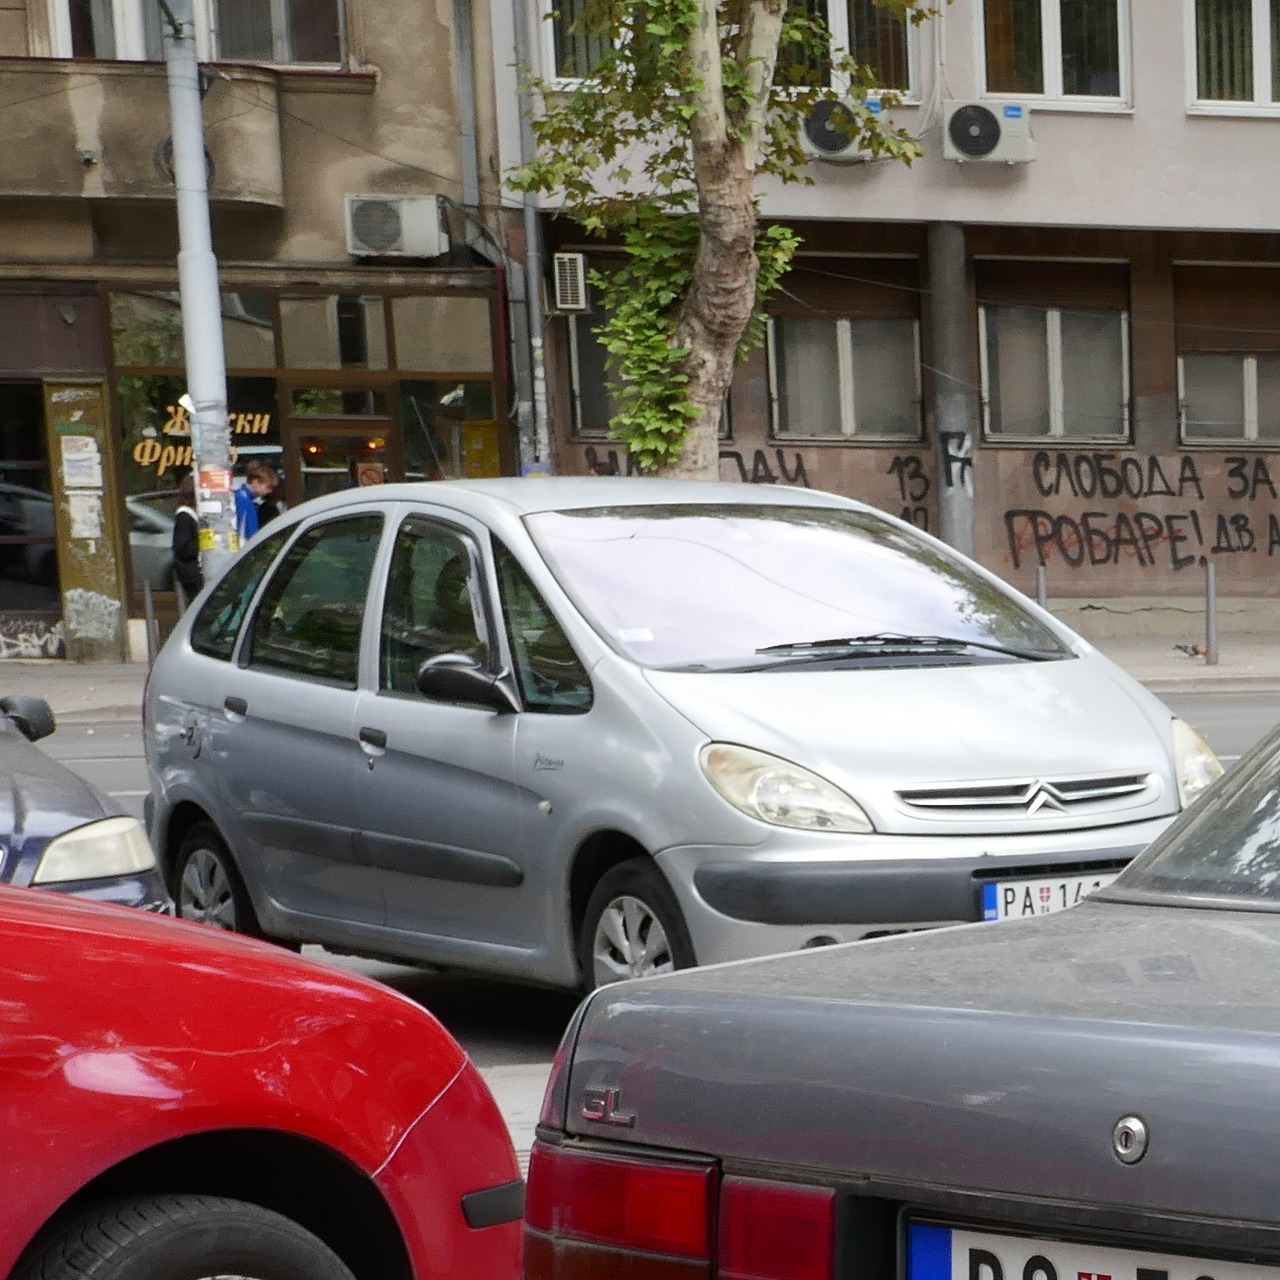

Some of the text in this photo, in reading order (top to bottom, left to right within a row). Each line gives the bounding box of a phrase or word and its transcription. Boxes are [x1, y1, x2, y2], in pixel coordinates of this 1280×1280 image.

[1032, 451, 1278, 500] СЛОБОДА ЗА
[1003, 508, 1208, 571] ГРОБАРЕ!
[1003, 886, 1035, 916] PA
